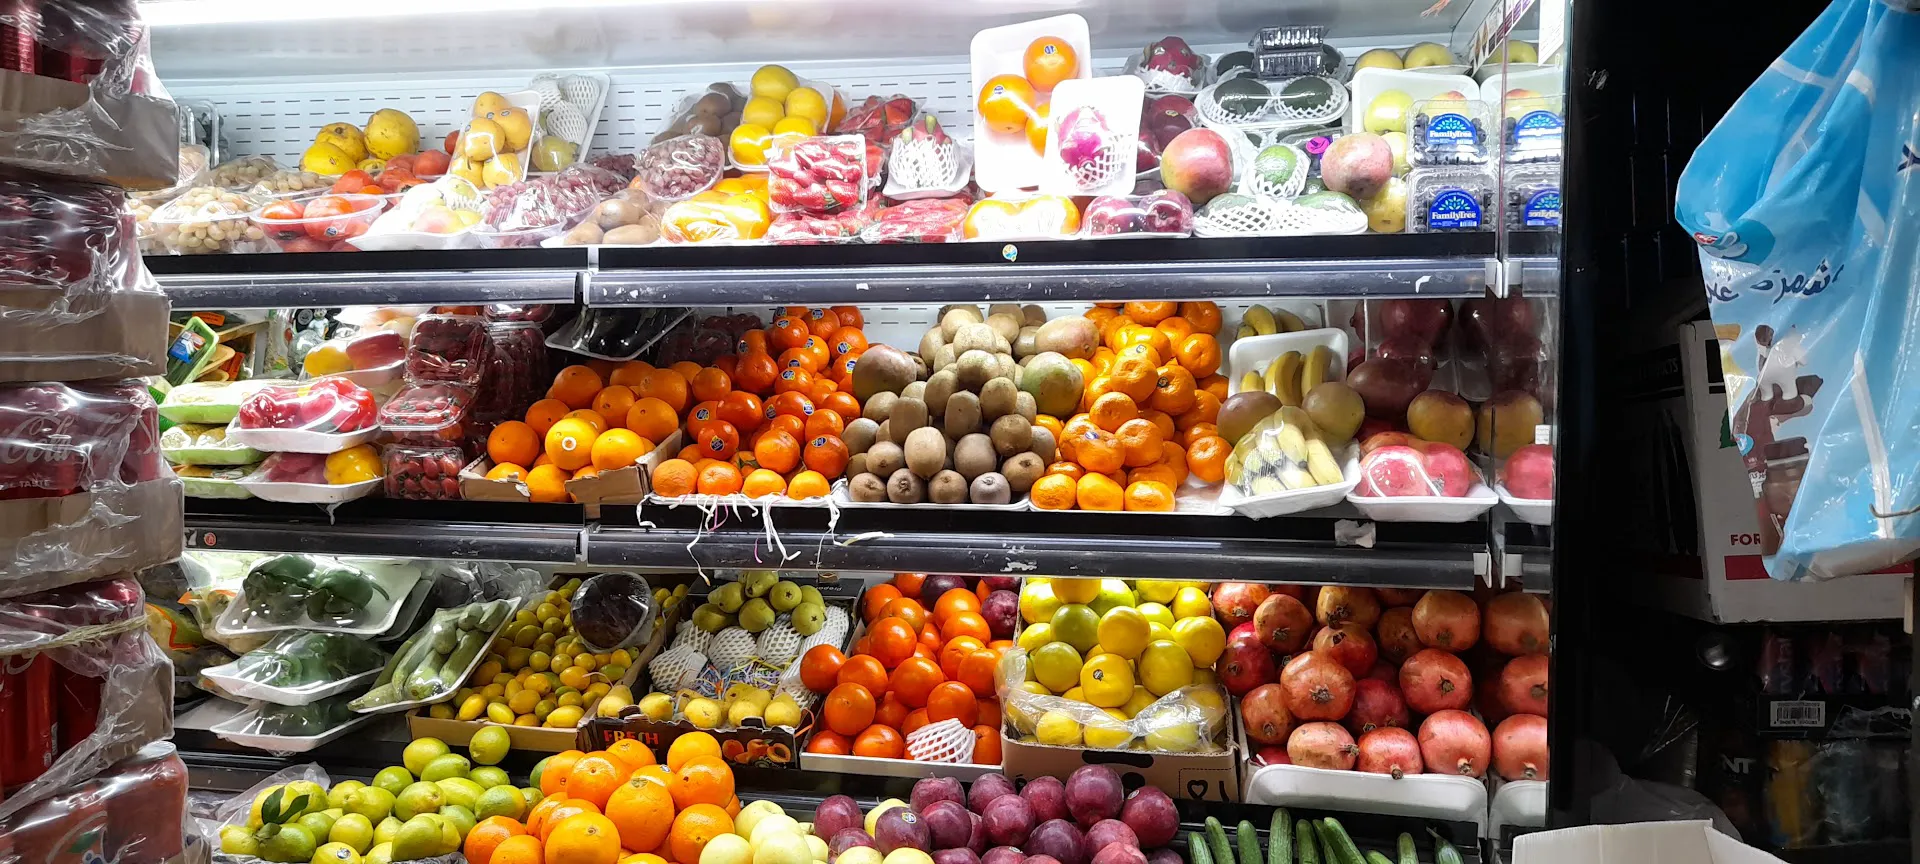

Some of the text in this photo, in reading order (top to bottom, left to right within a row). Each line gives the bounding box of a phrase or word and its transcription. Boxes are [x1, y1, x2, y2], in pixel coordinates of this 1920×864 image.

[1430, 130, 1473, 139] FamilyTree
[1432, 211, 1477, 221] FamilyTree
[19, 480, 51, 488] TASTE
[1730, 533, 1761, 546] FOR
[603, 729, 660, 745] FRESH
